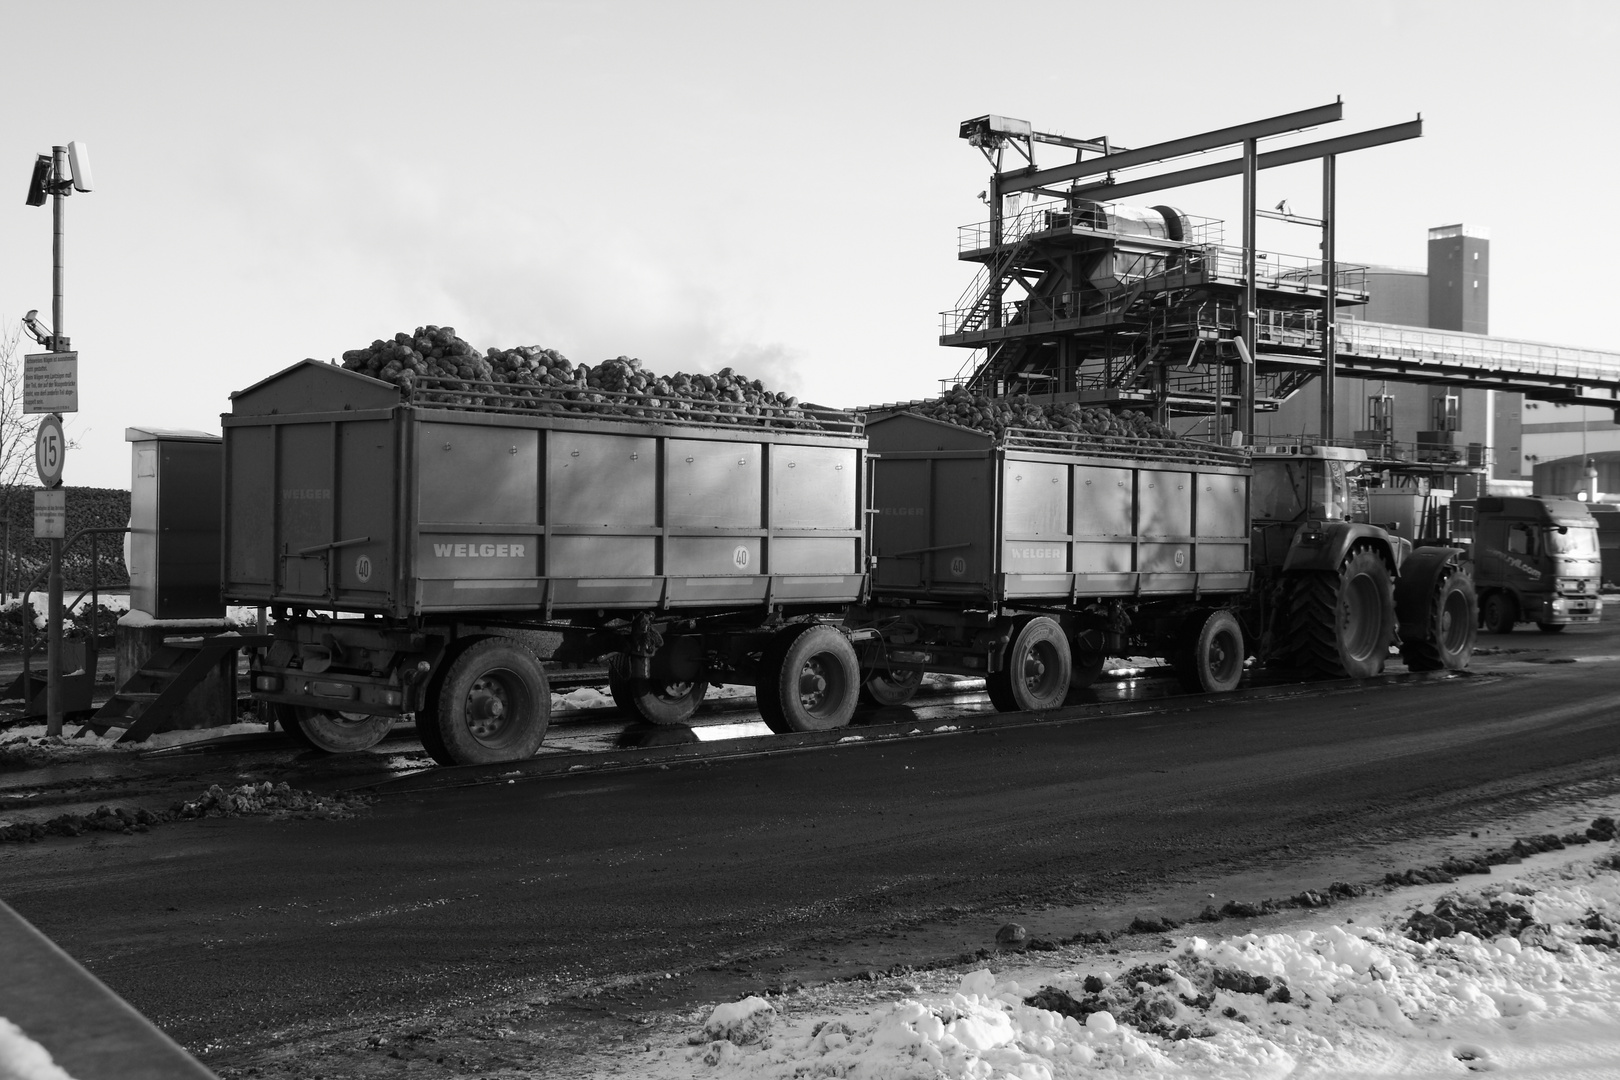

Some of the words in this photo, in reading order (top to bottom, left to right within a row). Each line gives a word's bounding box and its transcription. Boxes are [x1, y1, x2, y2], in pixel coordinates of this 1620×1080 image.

[43, 435, 57, 467] 15
[282, 488, 331, 500] WELGER
[433, 543, 525, 558] WELGER
[736, 550, 747, 565] 40
[1011, 548, 1061, 559] WELGER
[358, 560, 369, 578] 40
[953, 559, 963, 573] 40
